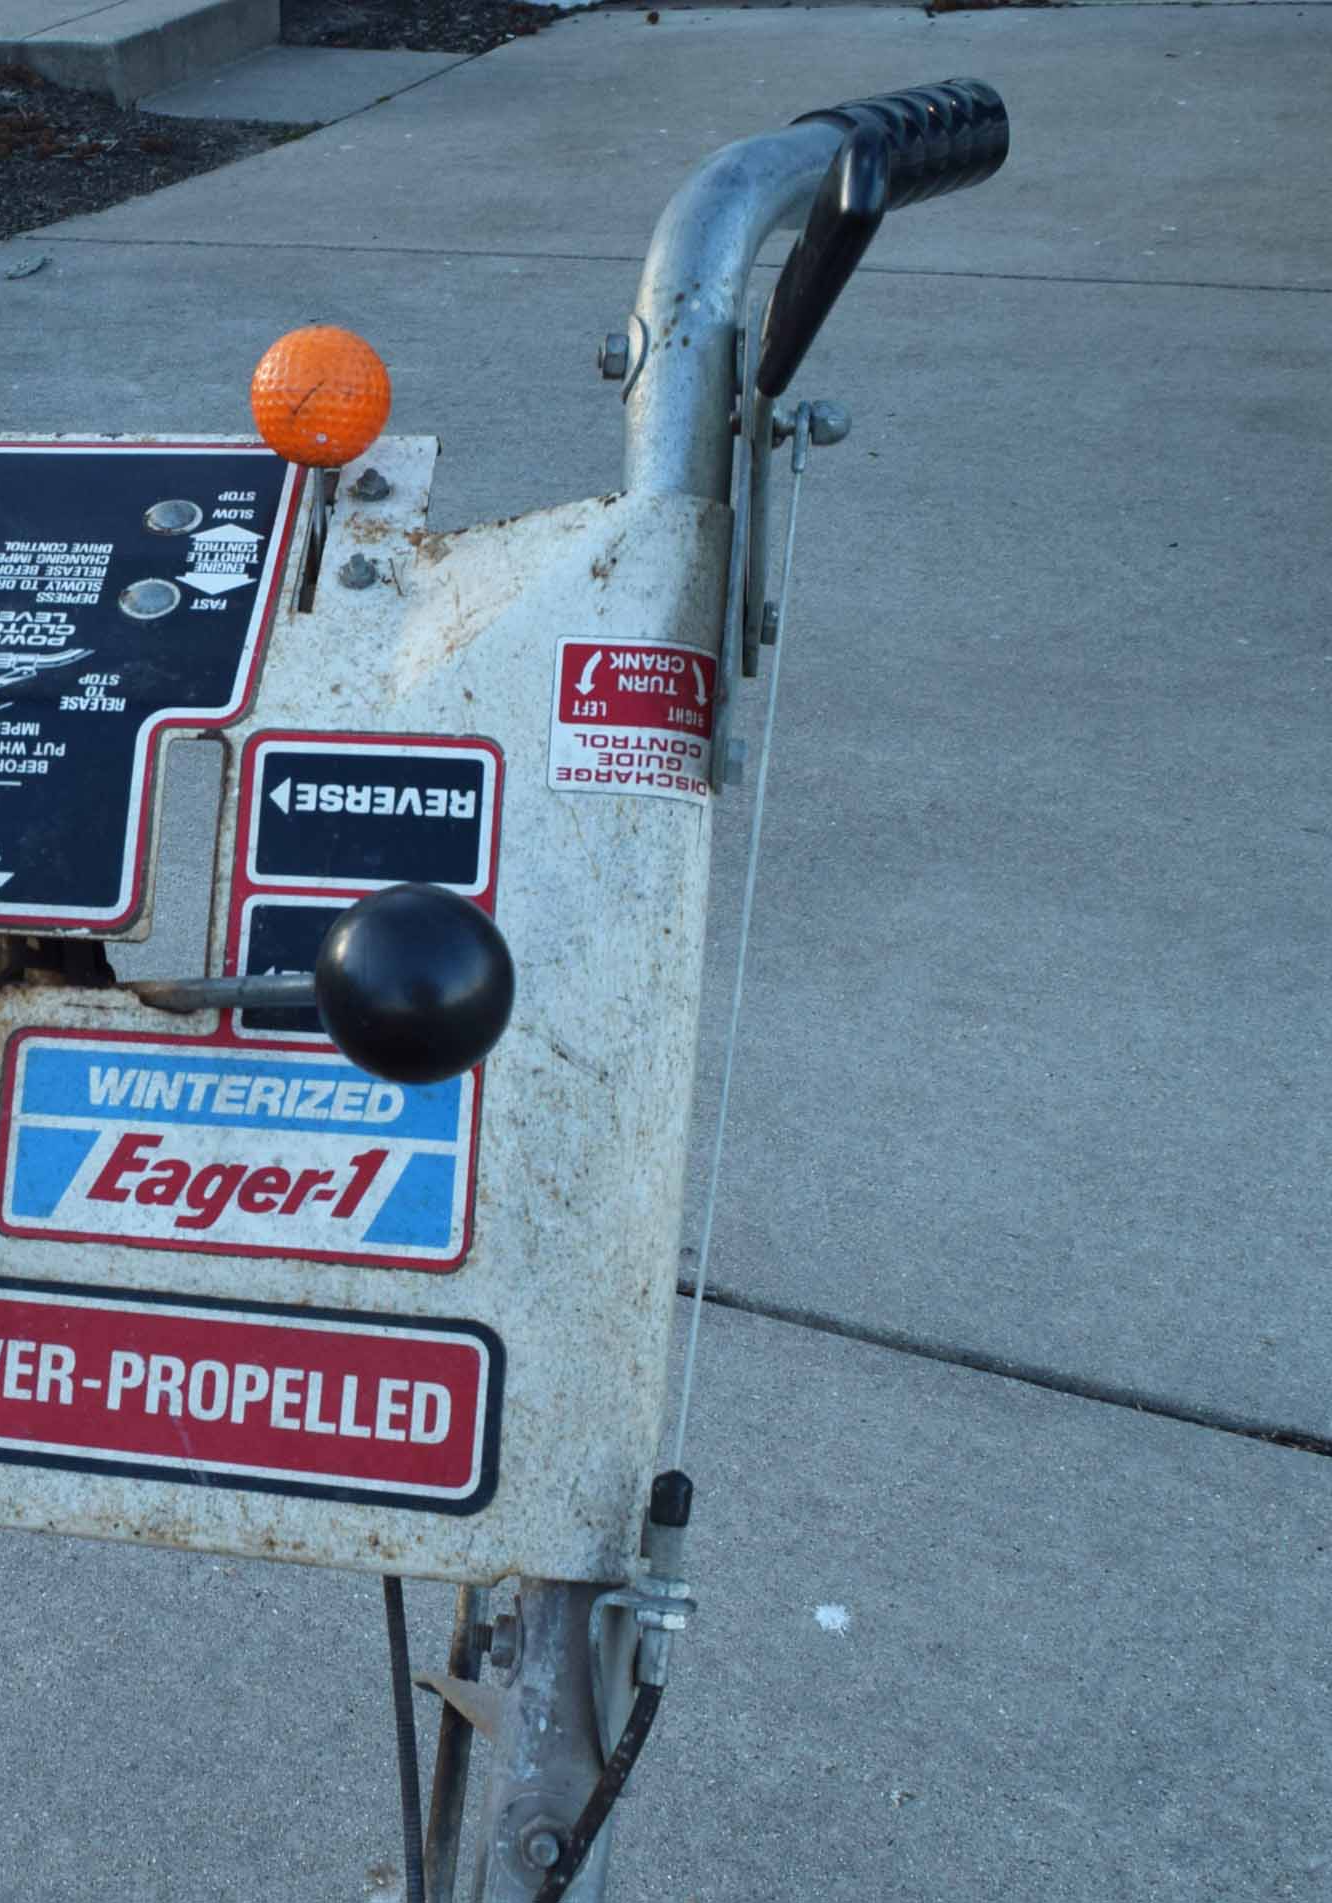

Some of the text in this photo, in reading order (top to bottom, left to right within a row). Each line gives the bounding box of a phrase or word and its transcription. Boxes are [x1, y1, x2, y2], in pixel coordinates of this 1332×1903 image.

[218, 491, 256, 501] STOP
[212, 509, 254, 519] SLOW
[4, 541, 114, 554] DRIVE CONTROL
[193, 542, 258, 552] CONTROL
[36, 554, 110, 565] CHANGING
[186, 552, 258, 564] THROTTLE
[44, 566, 107, 577] RELEASE
[194, 562, 246, 573] ENGINE
[20, 579, 38, 590] TO
[45, 580, 103, 592] SLOWLY
[36, 592, 99, 604] DEPRESS
[190, 599, 228, 610] FAST
[609, 652, 685, 673] CRANK
[78, 673, 120, 686] STOP
[618, 675, 678, 695] TURN
[85, 686, 106, 698] TO
[60, 696, 126, 712] RELEASE
[572, 700, 607, 717] LEFT
[668, 707, 705, 727] RIGHT
[32, 742, 66, 757] PUT
[574, 733, 701, 759] CONTROL
[597, 752, 682, 771] GUIDE
[556, 767, 707, 796] DISCHARGE
[295, 782, 477, 819] REVERSE
[87, 1065, 406, 1123] WINTERIZED
[85, 1131, 390, 1230] Eager-1
